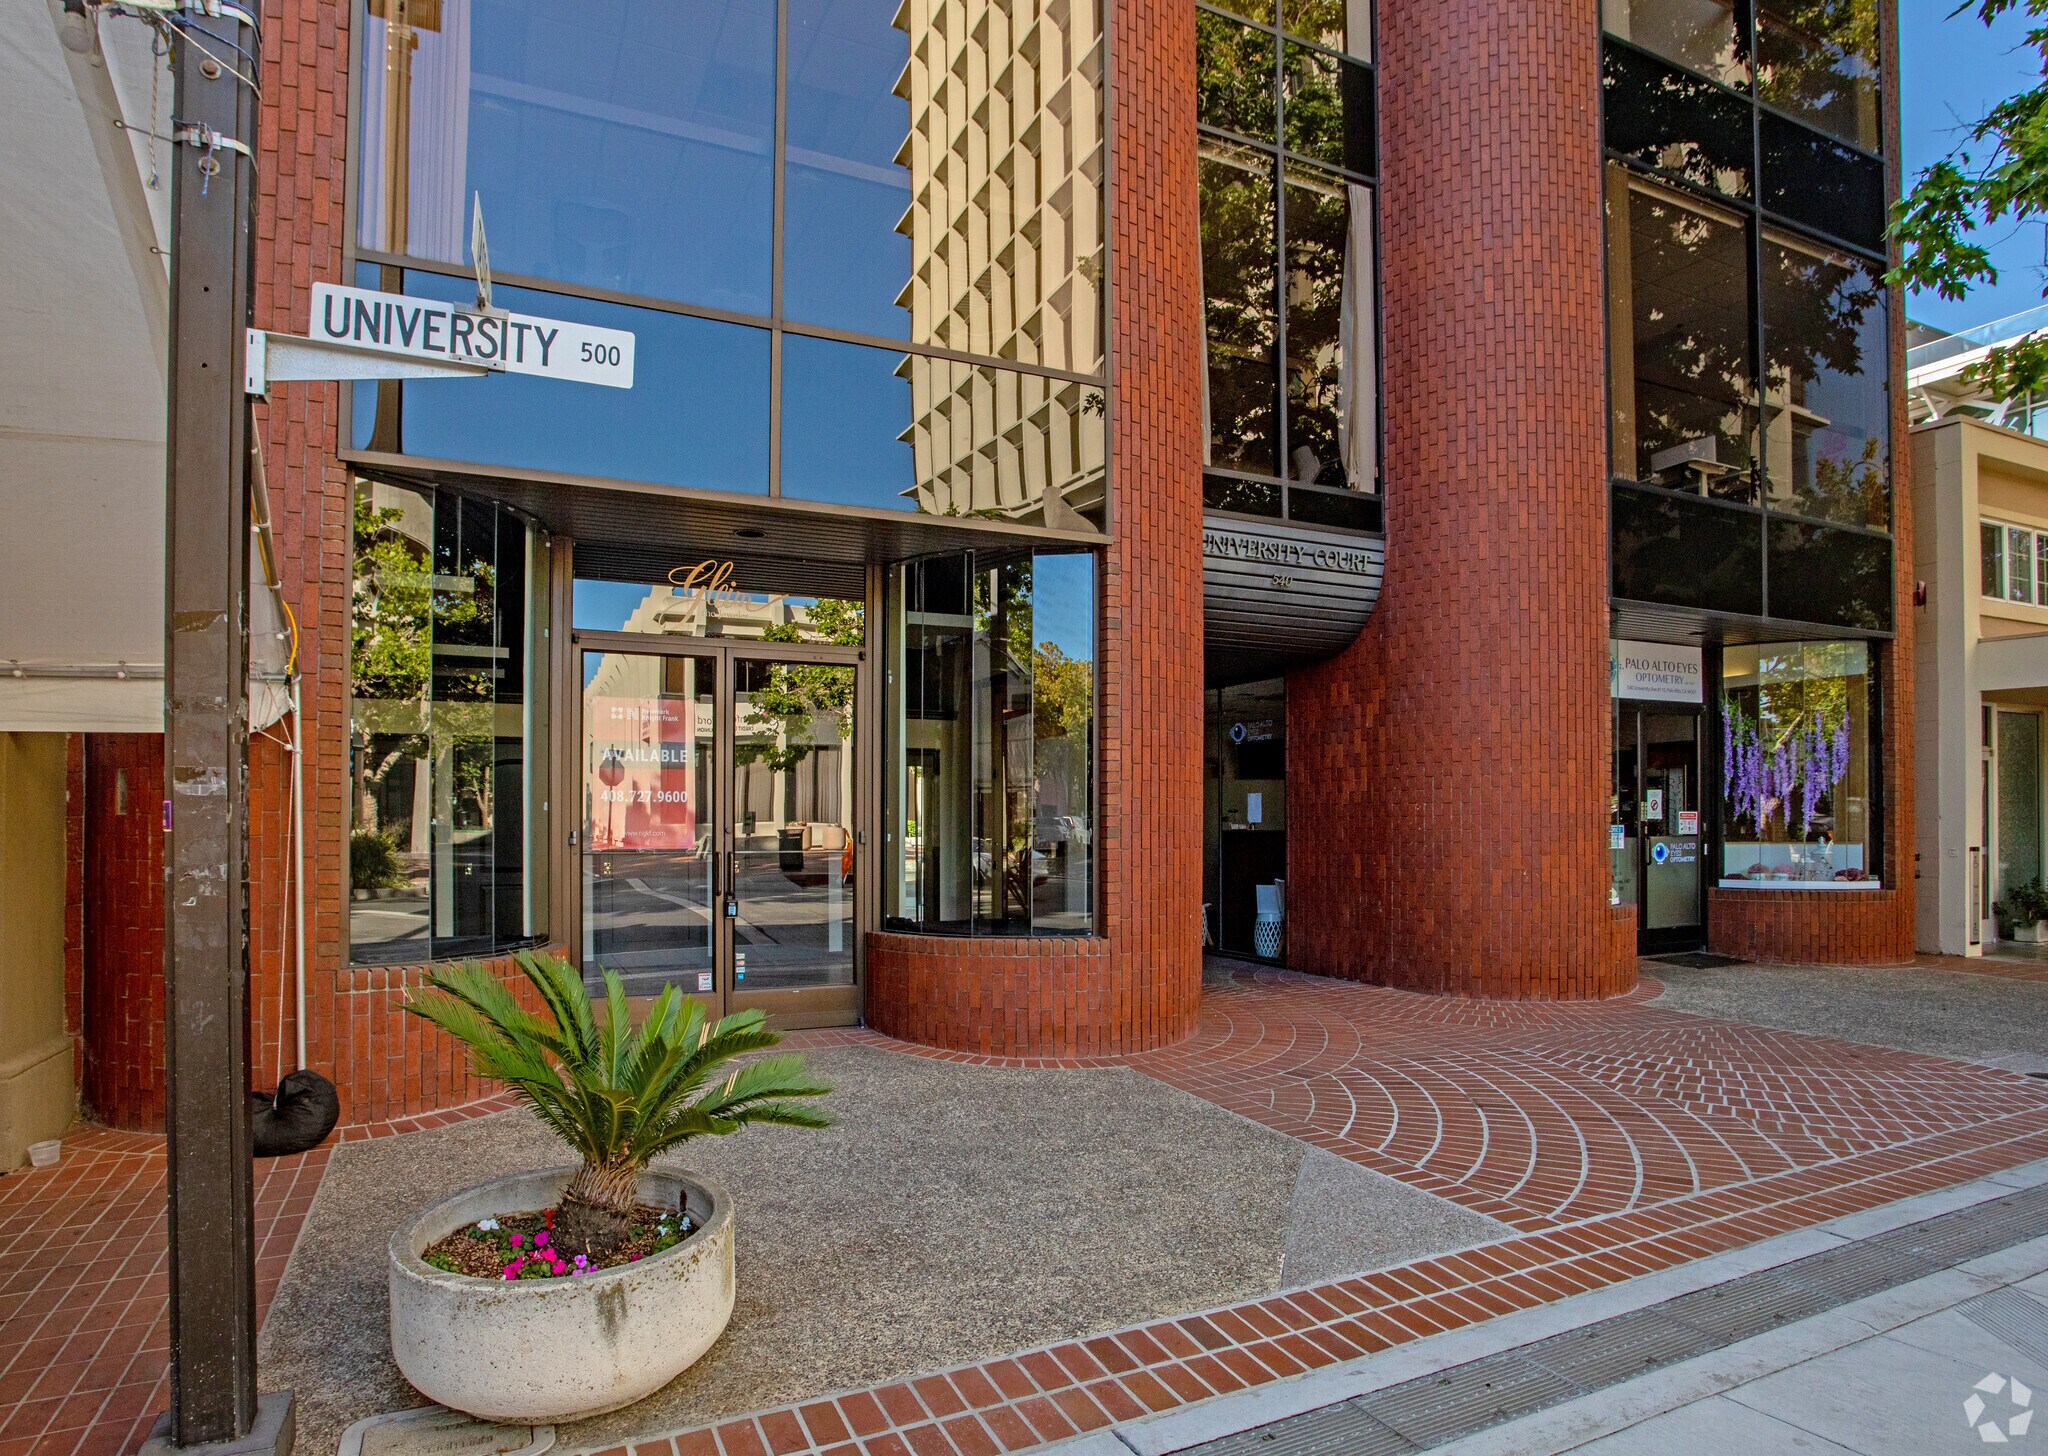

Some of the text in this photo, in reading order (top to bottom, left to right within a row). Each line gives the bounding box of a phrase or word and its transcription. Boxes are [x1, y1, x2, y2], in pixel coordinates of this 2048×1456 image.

[324, 294, 621, 367] UNIVERSITY 500
[1313, 549, 1372, 572] COURT
[1272, 573, 1293, 587] 540
[1625, 658, 1698, 674] PALO ALTO EYES
[1635, 672, 1684, 685] OPTOMETRY
[602, 748, 688, 763] AVAILABLE
[600, 790, 688, 803] 408.727.9600
[1683, 842, 1696, 850] ALTO
[1669, 855, 1696, 863] OPTOMETRY
